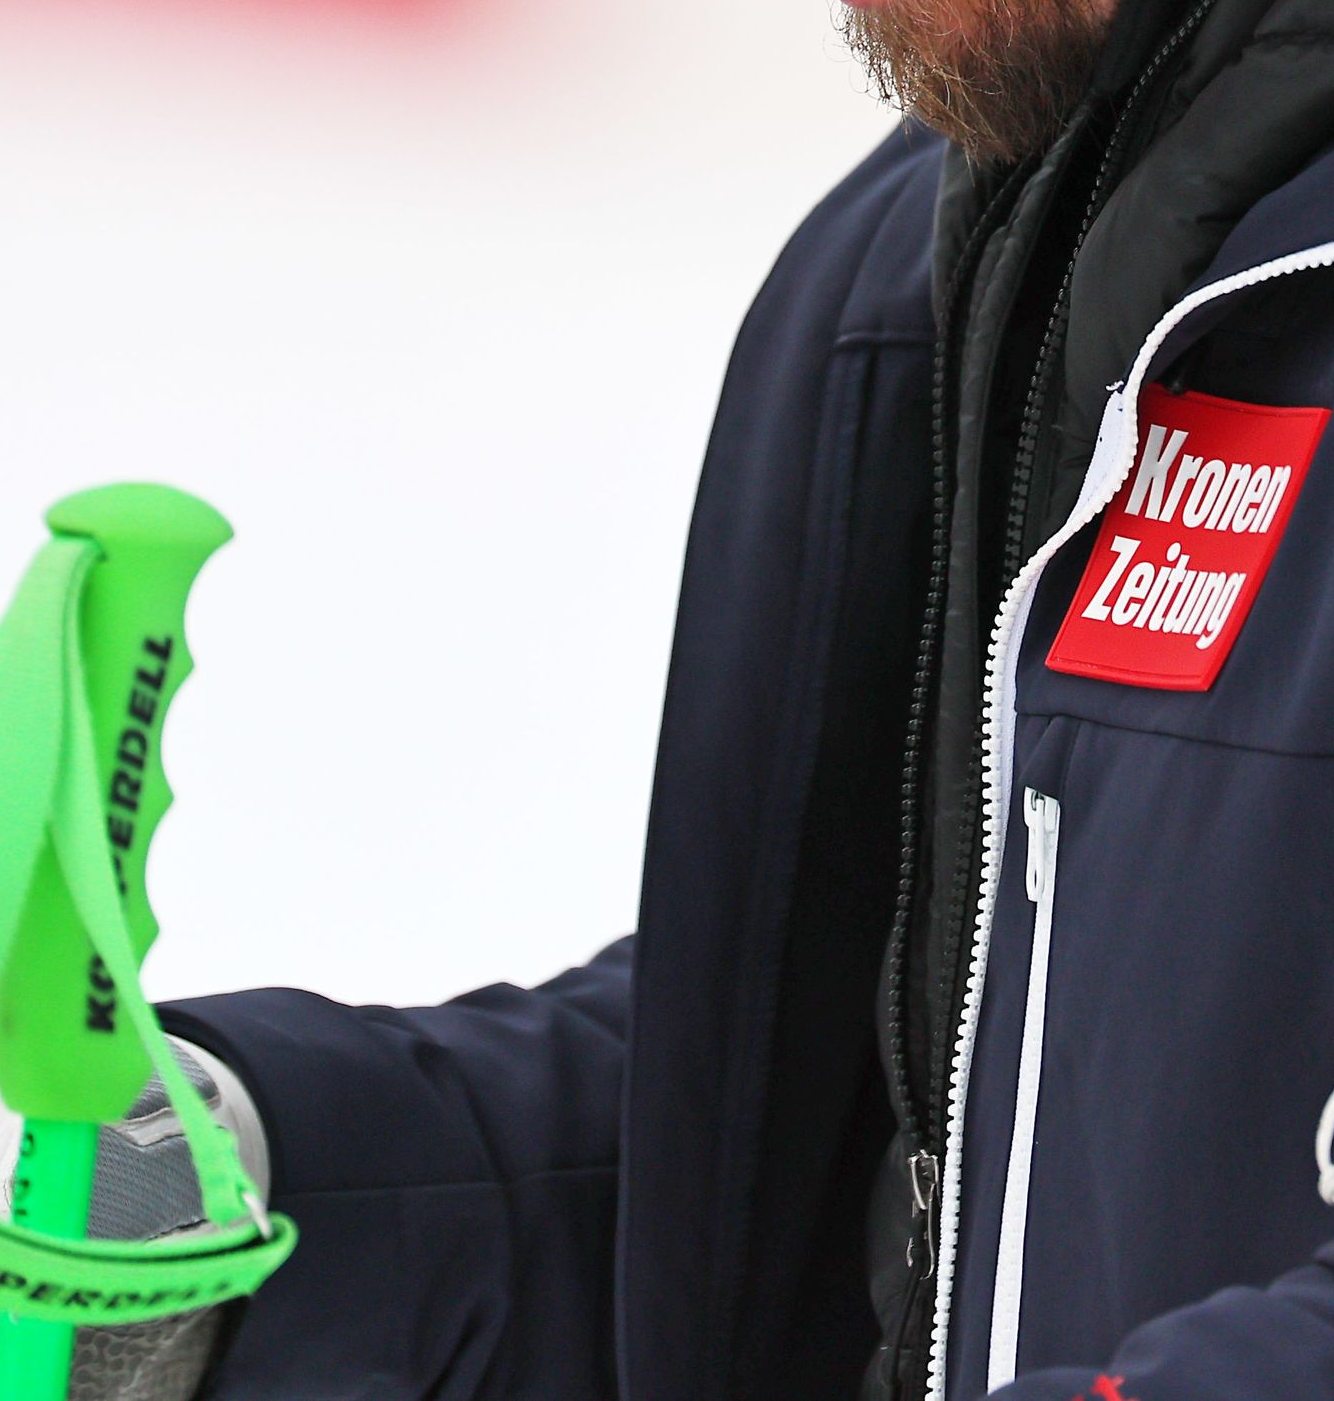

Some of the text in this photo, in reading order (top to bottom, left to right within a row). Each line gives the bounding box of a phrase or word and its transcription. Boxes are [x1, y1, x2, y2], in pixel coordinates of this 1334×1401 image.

[1124, 424, 1291, 534] Kronen
[1081, 535, 1247, 650] Zeitung
[85, 633, 175, 1034] KOERDELL
